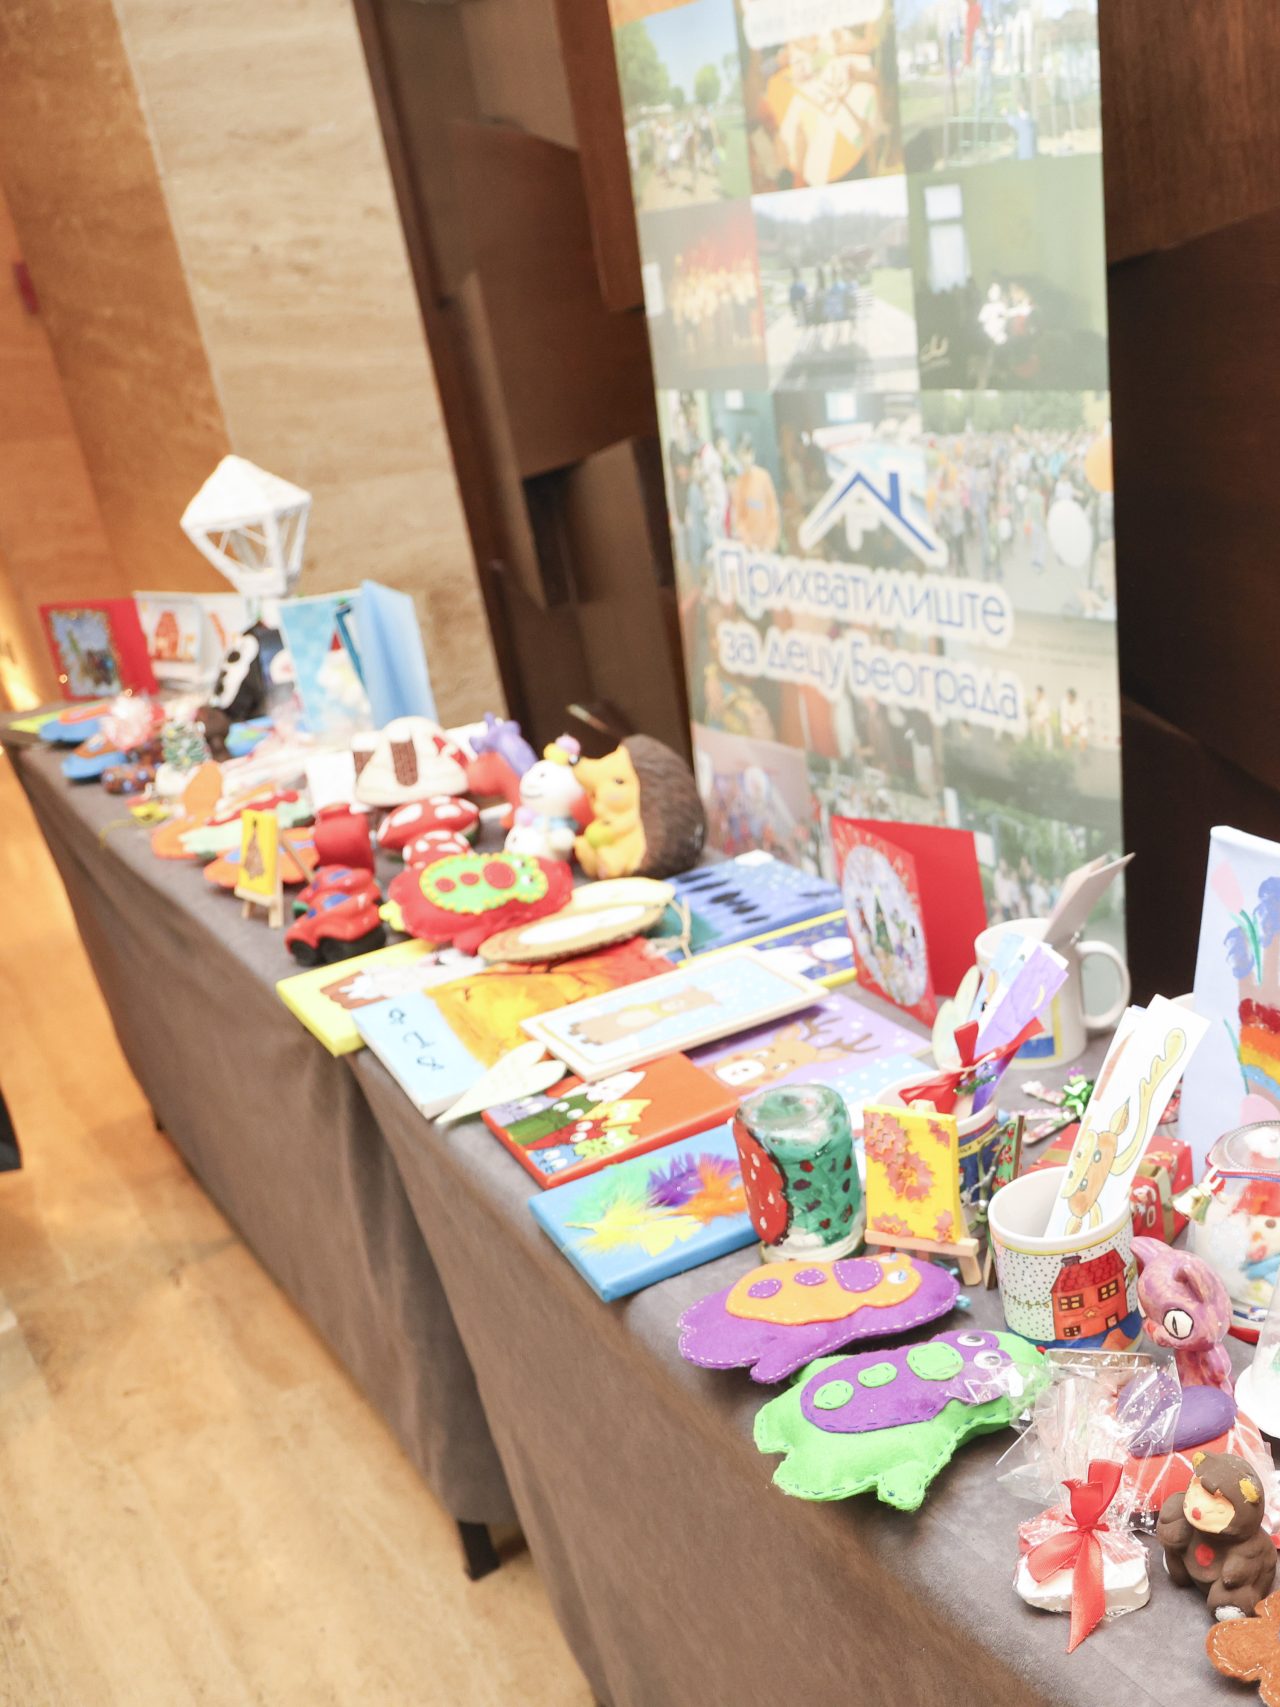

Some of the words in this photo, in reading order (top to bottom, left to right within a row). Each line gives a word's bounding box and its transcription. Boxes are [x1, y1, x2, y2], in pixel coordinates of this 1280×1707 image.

[719, 549, 1005, 636] Прихватилиште
[722, 629, 757, 667] за
[767, 640, 843, 691] децу
[852, 640, 1019, 721] Београда
